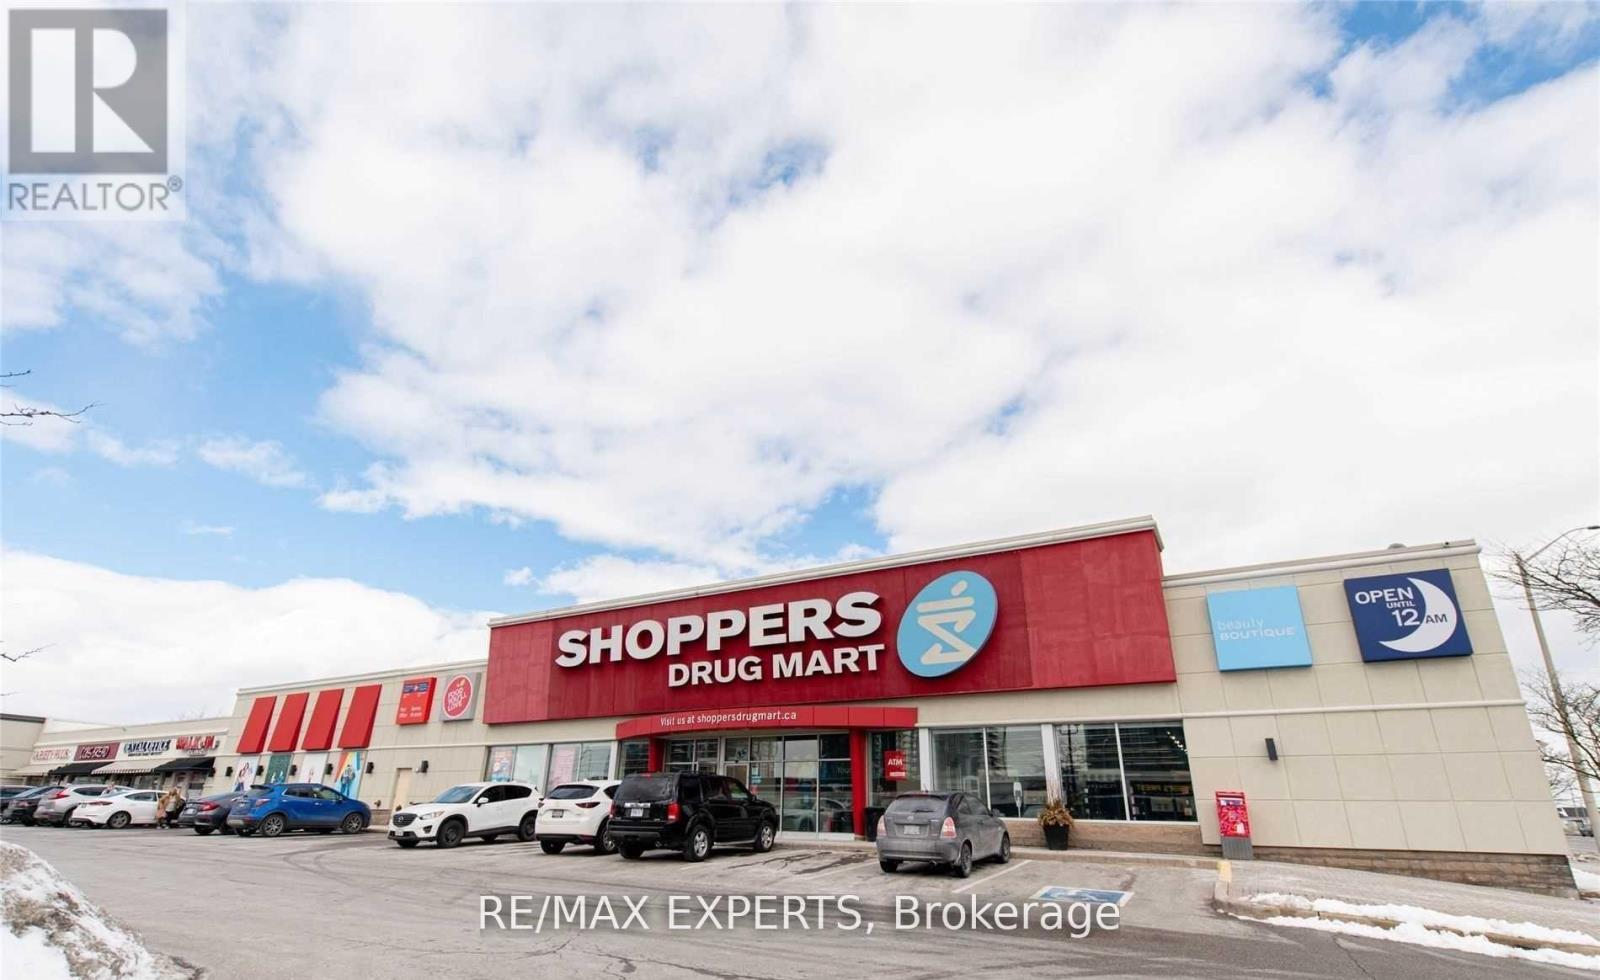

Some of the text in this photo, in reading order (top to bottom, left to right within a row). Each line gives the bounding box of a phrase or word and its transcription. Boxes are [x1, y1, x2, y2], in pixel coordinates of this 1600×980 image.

[1355, 587, 1414, 605] OPEN
[1386, 600, 1416, 609] UNTIL
[1217, 618, 1264, 631] beauty
[1392, 608, 1448, 627] 12 AM
[555, 591, 882, 668] SHOPPERS
[1220, 627, 1296, 641] BOUTIQUE
[668, 644, 885, 688] DRUG MART
[660, 710, 797, 727] Visit us at shoppersdrugmart.ca
[888, 758, 903, 766] ATM
